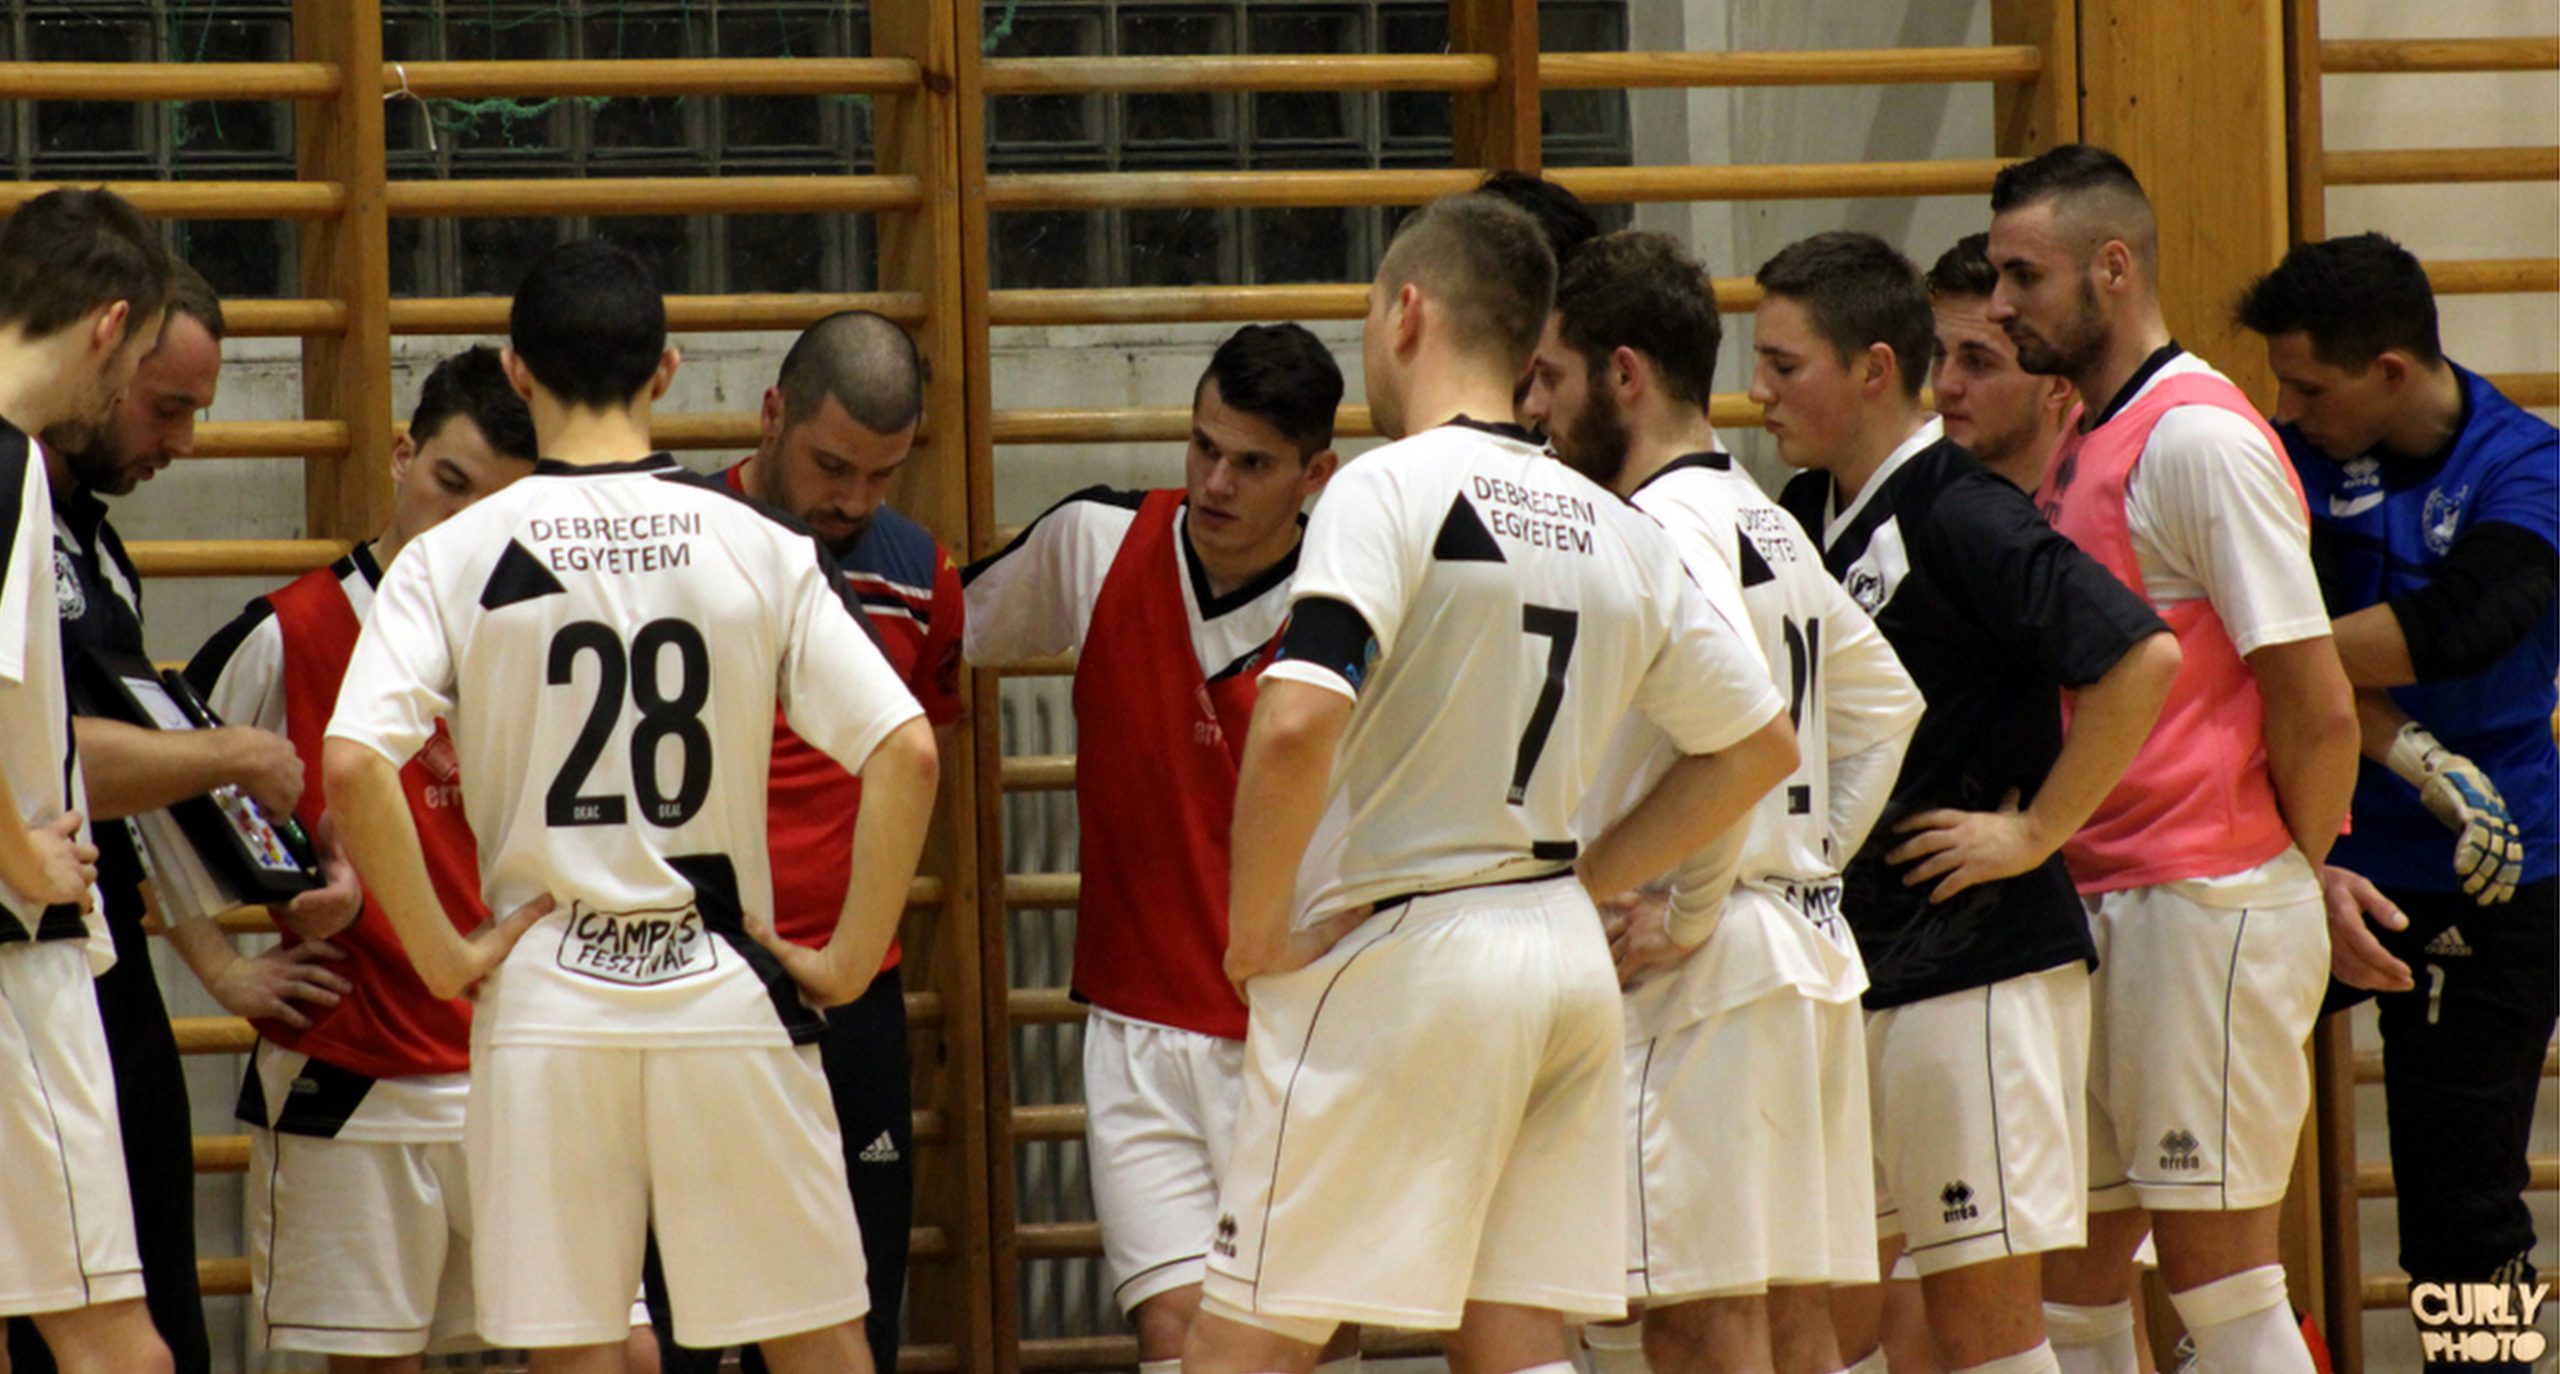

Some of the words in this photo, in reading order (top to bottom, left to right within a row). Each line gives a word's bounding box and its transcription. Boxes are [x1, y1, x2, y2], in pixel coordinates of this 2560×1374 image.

[1473, 475, 1597, 527] DEBRECENI
[529, 512, 702, 543] DEBRECENI
[1490, 509, 1594, 556] EGYETEM
[550, 542, 691, 575] EGYETEM
[546, 617, 713, 828] 28
[1506, 602, 1579, 806] 7
[2426, 962, 2446, 1025] 1
